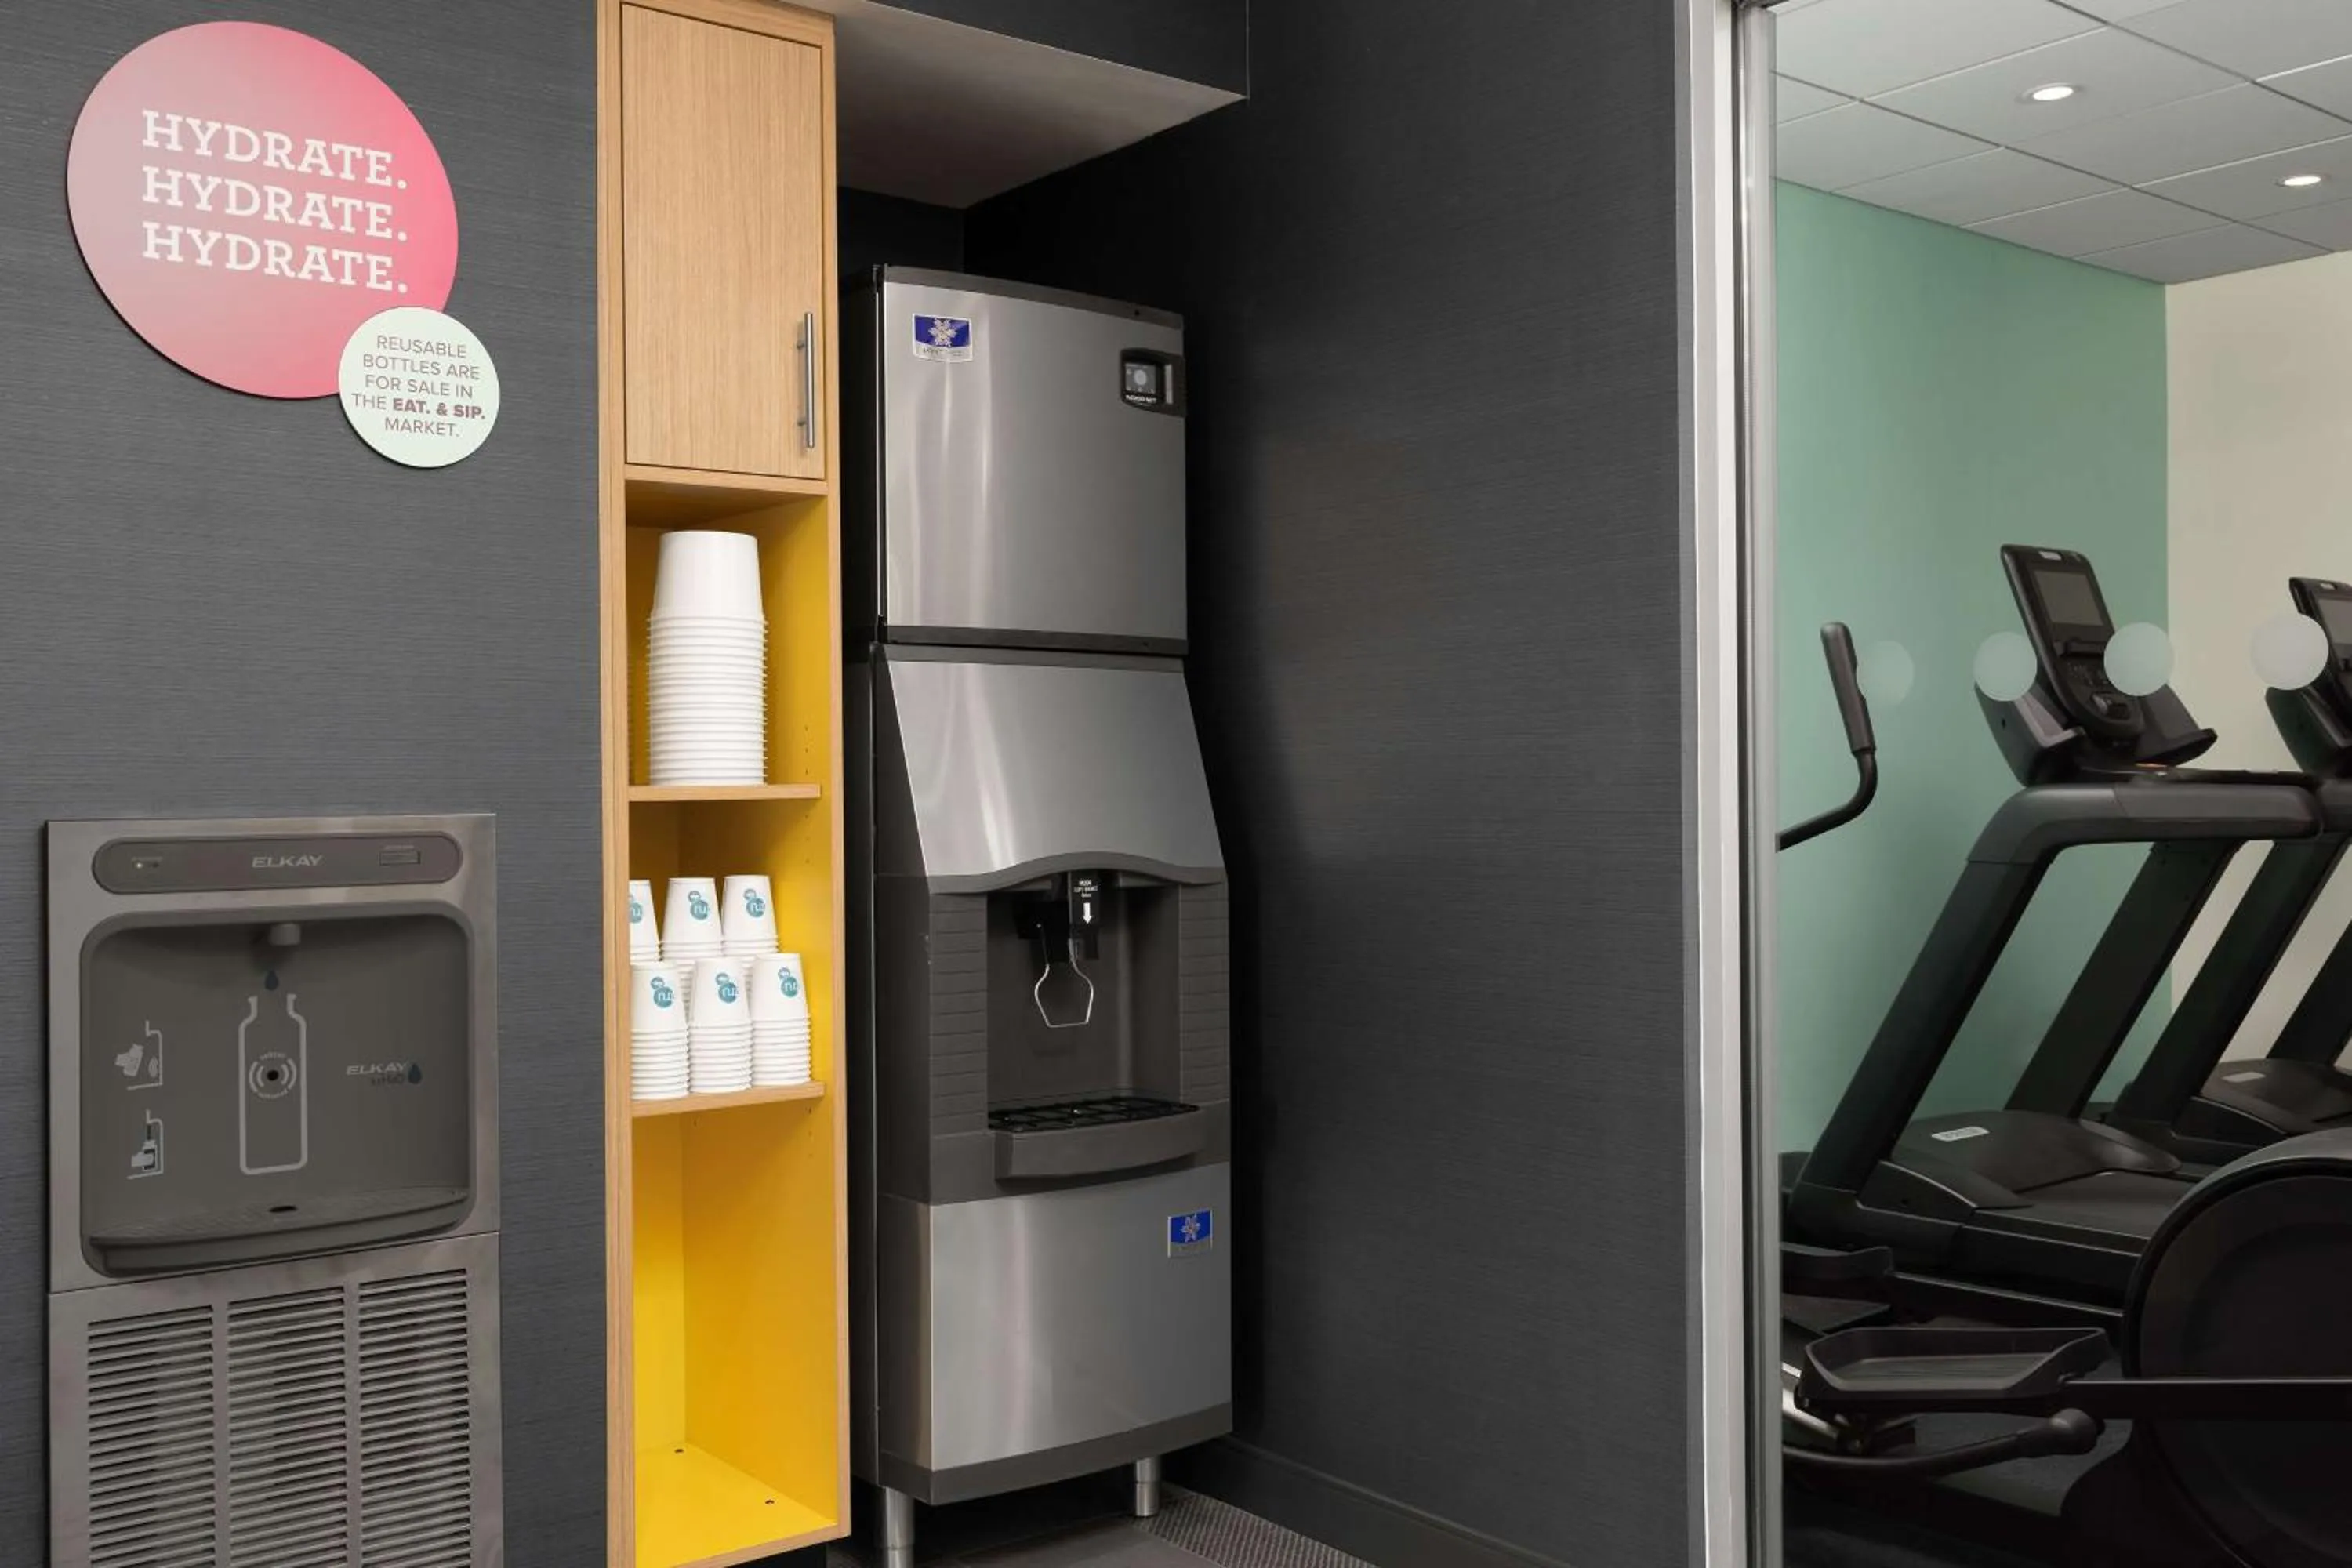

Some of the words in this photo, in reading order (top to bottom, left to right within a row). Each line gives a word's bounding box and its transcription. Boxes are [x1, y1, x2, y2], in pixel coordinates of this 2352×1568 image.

[142, 109, 408, 189] HYDRATE.
[142, 165, 408, 241] HYDRATE.
[142, 221, 408, 293] HYDRATE.
[377, 335, 466, 358] REUSABLE
[363, 354, 441, 376] BOTTLES
[446, 364, 481, 380] ARE
[365, 374, 401, 391] FOR
[407, 379, 450, 397] SALE
[456, 383, 473, 399] IN
[351, 393, 387, 410] THE
[393, 397, 430, 415] EAT.
[436, 402, 448, 416] &
[453, 404, 486, 420] SIP.
[384, 416, 460, 437] MARKET.
[252, 855, 323, 868] ELKAY
[347, 1061, 409, 1075] ELKAY
